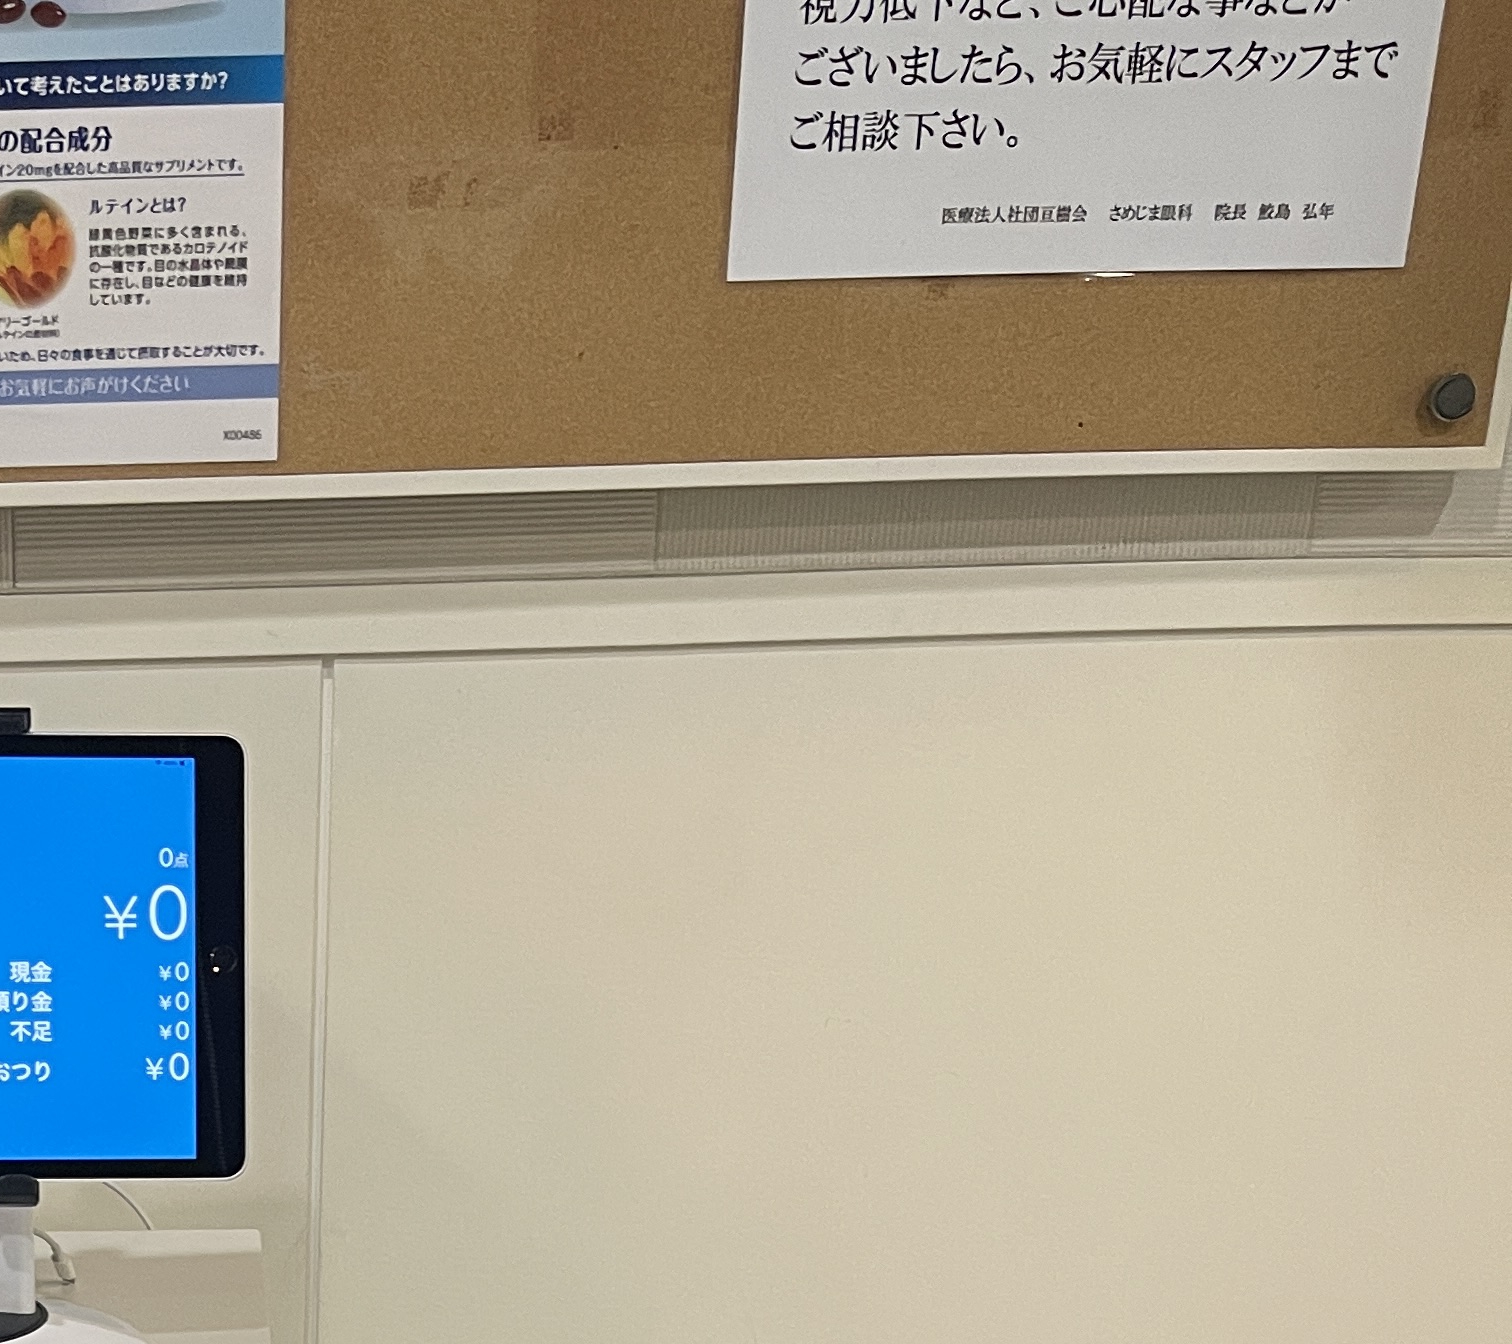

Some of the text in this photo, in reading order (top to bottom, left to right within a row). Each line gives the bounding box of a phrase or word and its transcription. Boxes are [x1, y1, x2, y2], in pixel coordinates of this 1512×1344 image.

[794, 40, 1399, 87] ございましたら、お気軽にスタッフまで
[790, 111, 1021, 153] ご相談下さい。
[89, 198, 187, 215] ルテインとは?
[159, 847, 189, 868] 0点
[103, 884, 188, 940] ¥0
[9, 961, 53, 983] 現金
[158, 961, 190, 982] ¥0
[158, 991, 190, 1012] ¥0
[10, 1021, 53, 1042] 不足
[158, 1020, 190, 1041] ¥0
[145, 1052, 190, 1081] ¥0
